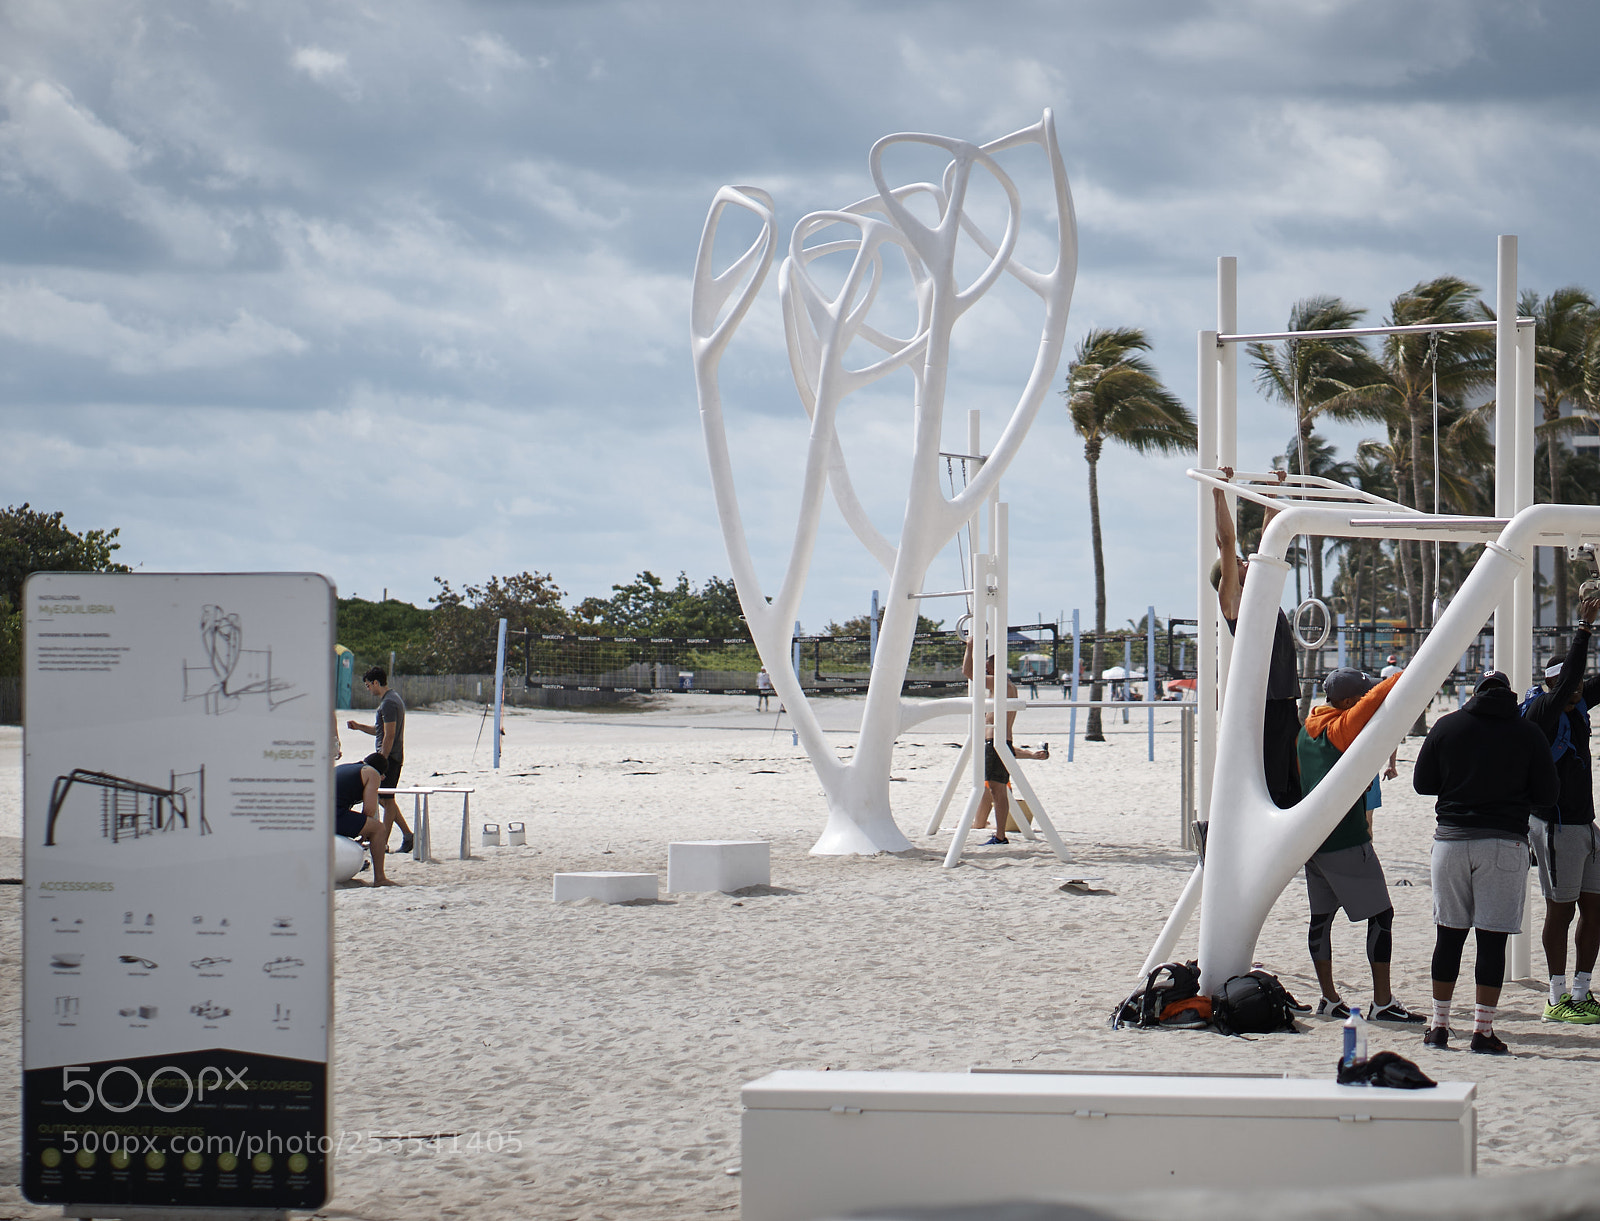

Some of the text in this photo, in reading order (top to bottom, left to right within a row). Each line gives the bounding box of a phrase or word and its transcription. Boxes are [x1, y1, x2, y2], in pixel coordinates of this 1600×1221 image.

[263, 749, 315, 761] MyBEAST
[39, 881, 114, 892] ACCESSORIES
[260, 1080, 312, 1091] COVERED
